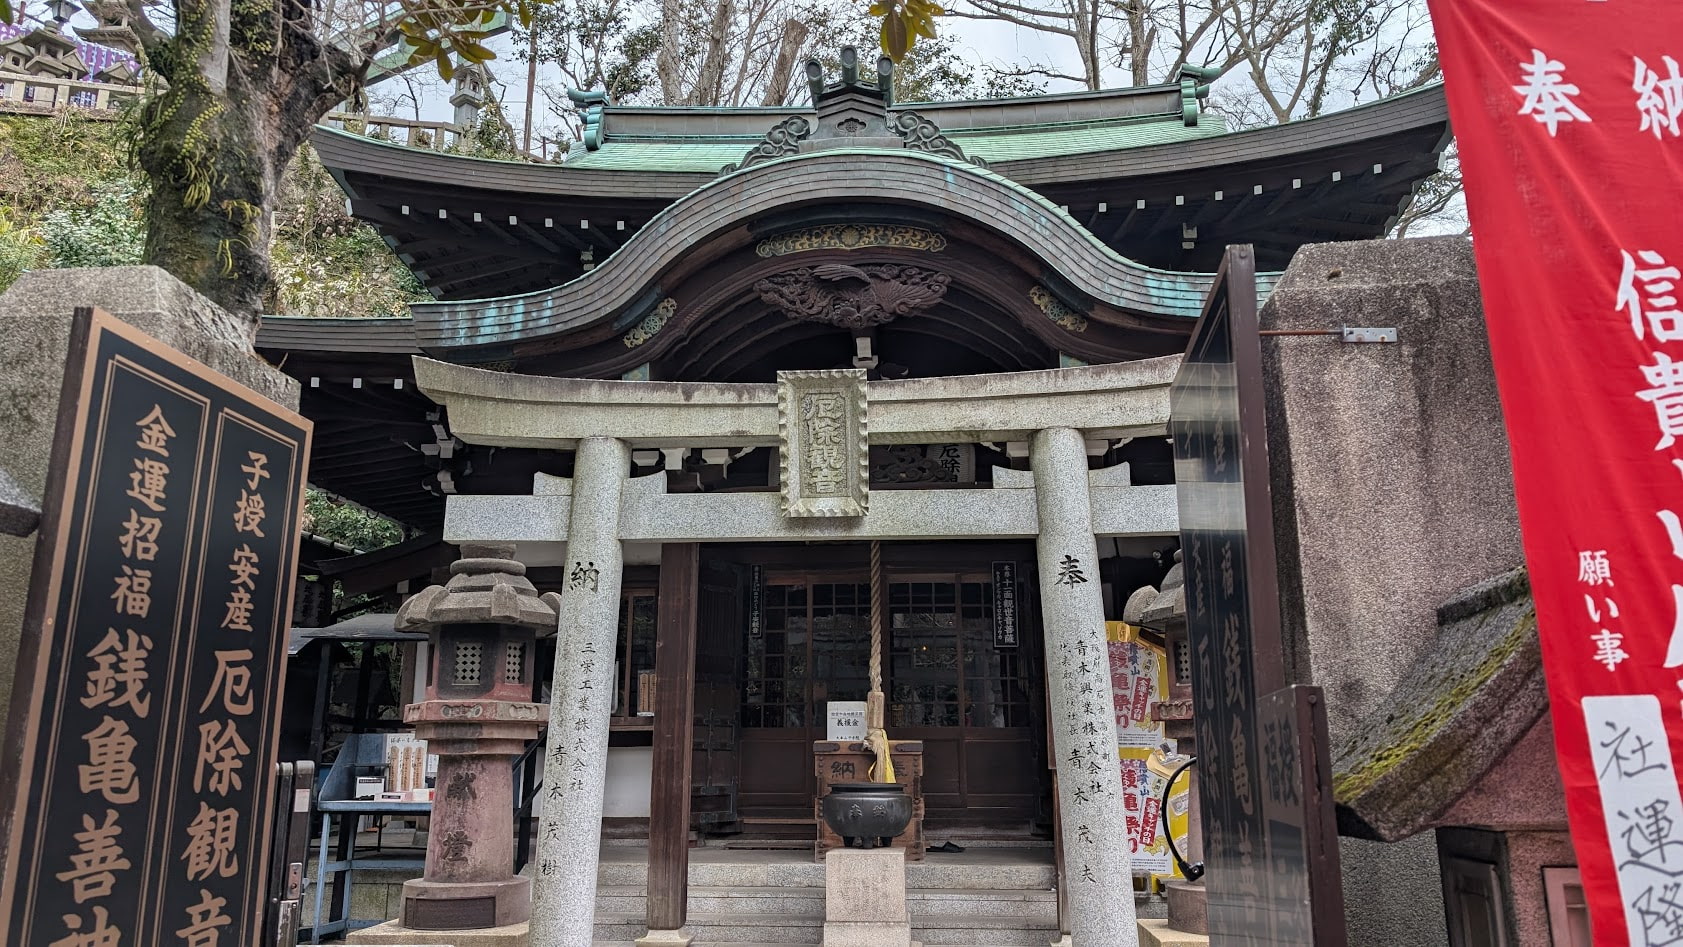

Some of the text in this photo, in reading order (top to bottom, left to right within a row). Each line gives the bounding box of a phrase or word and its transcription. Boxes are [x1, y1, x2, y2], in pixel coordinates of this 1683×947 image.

[803, 396, 844, 494] 厄除観音
[570, 561, 600, 593] 納
[1054, 554, 1088, 589] 奉
[1578, 550, 1629, 671] 願い事
[569, 642, 597, 792] 三栄工業株式会社
